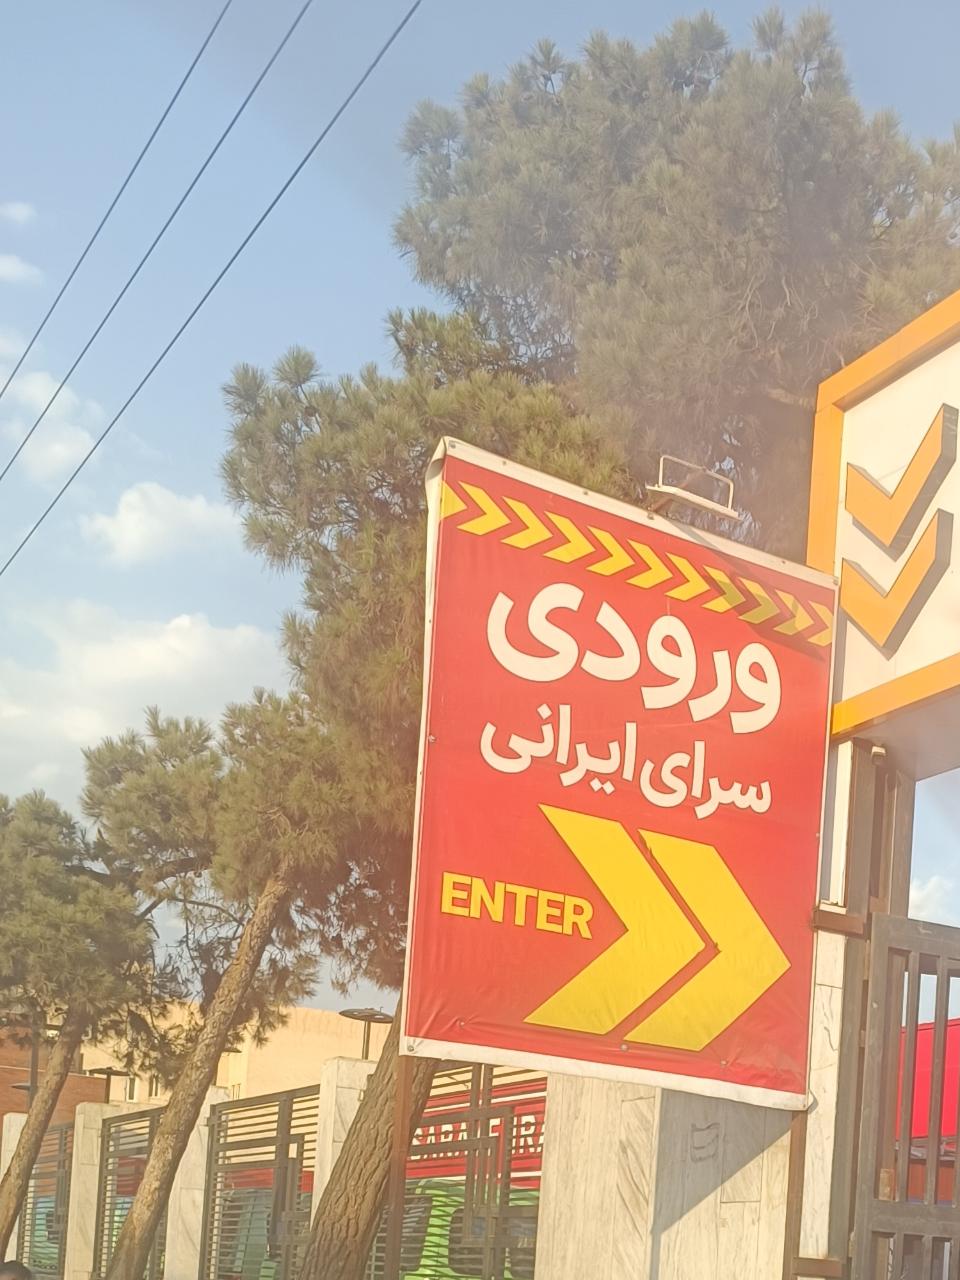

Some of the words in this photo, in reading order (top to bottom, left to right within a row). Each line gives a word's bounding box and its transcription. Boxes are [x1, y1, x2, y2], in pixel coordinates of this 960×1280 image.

[486, 582, 782, 734] ورودی
[480, 703, 637, 795] ایرانی
[639, 739, 772, 820] سرای
[440, 871, 594, 940] ENTER
